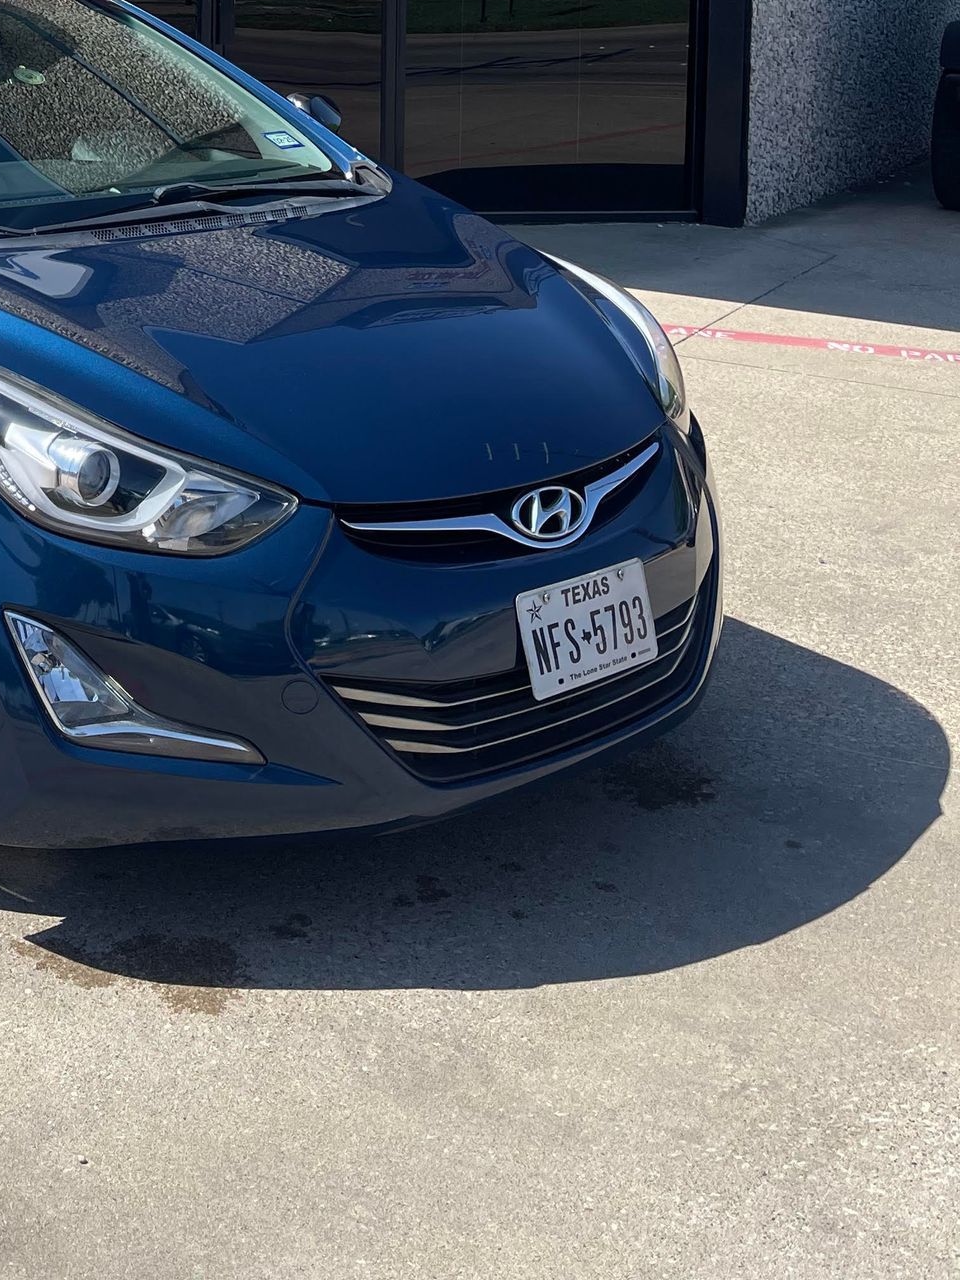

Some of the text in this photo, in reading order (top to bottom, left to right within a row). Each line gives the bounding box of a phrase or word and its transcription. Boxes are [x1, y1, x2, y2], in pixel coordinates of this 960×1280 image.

[826, 341, 874, 354] NO
[560, 576, 610, 607] TEXAS
[569, 655, 628, 681] The Lone Star State
